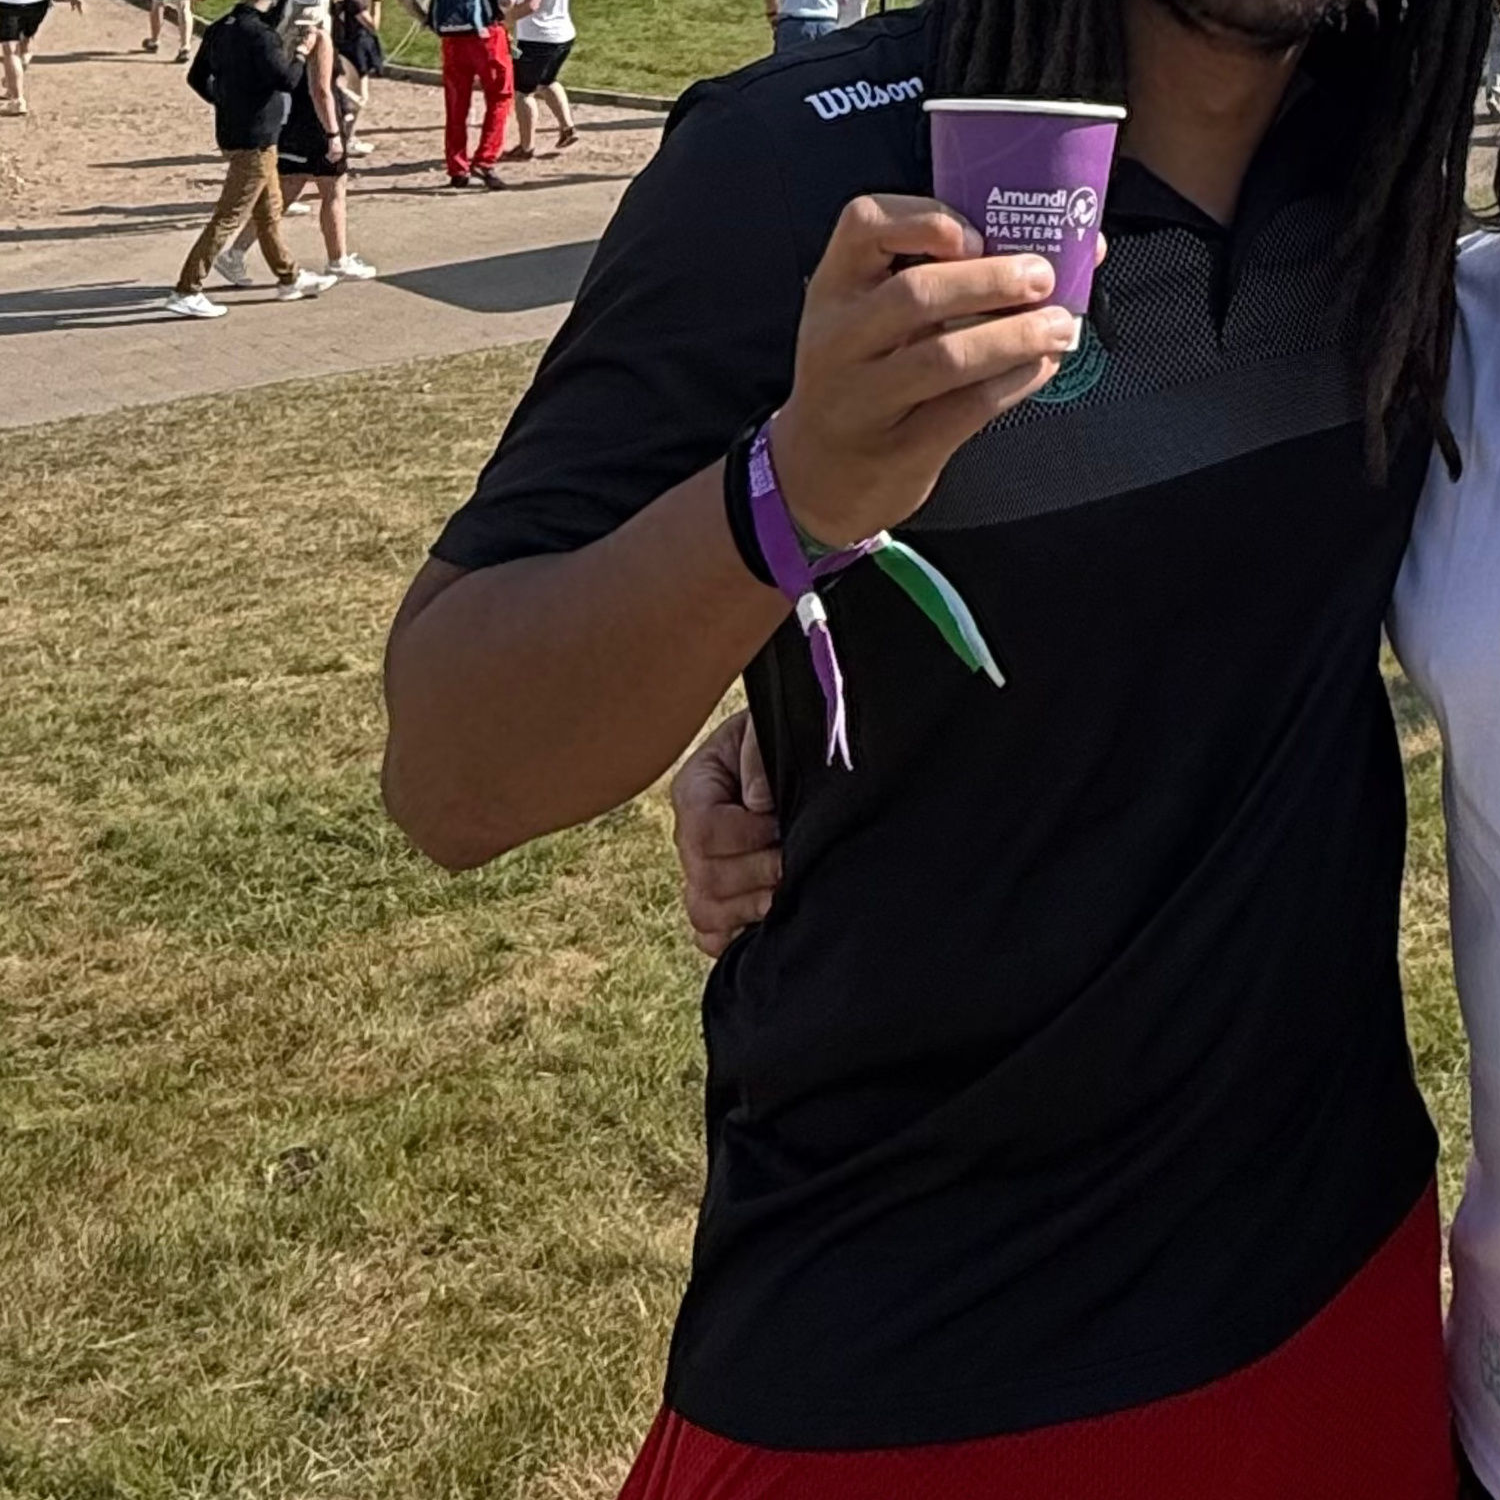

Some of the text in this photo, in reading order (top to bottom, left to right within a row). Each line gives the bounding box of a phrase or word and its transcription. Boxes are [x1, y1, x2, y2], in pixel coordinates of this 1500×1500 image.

[804, 76, 924, 120] Wilson
[987, 186, 1067, 206] Amundi
[985, 211, 1059, 225] GERMAN
[985, 226, 1063, 240] MASTERS
